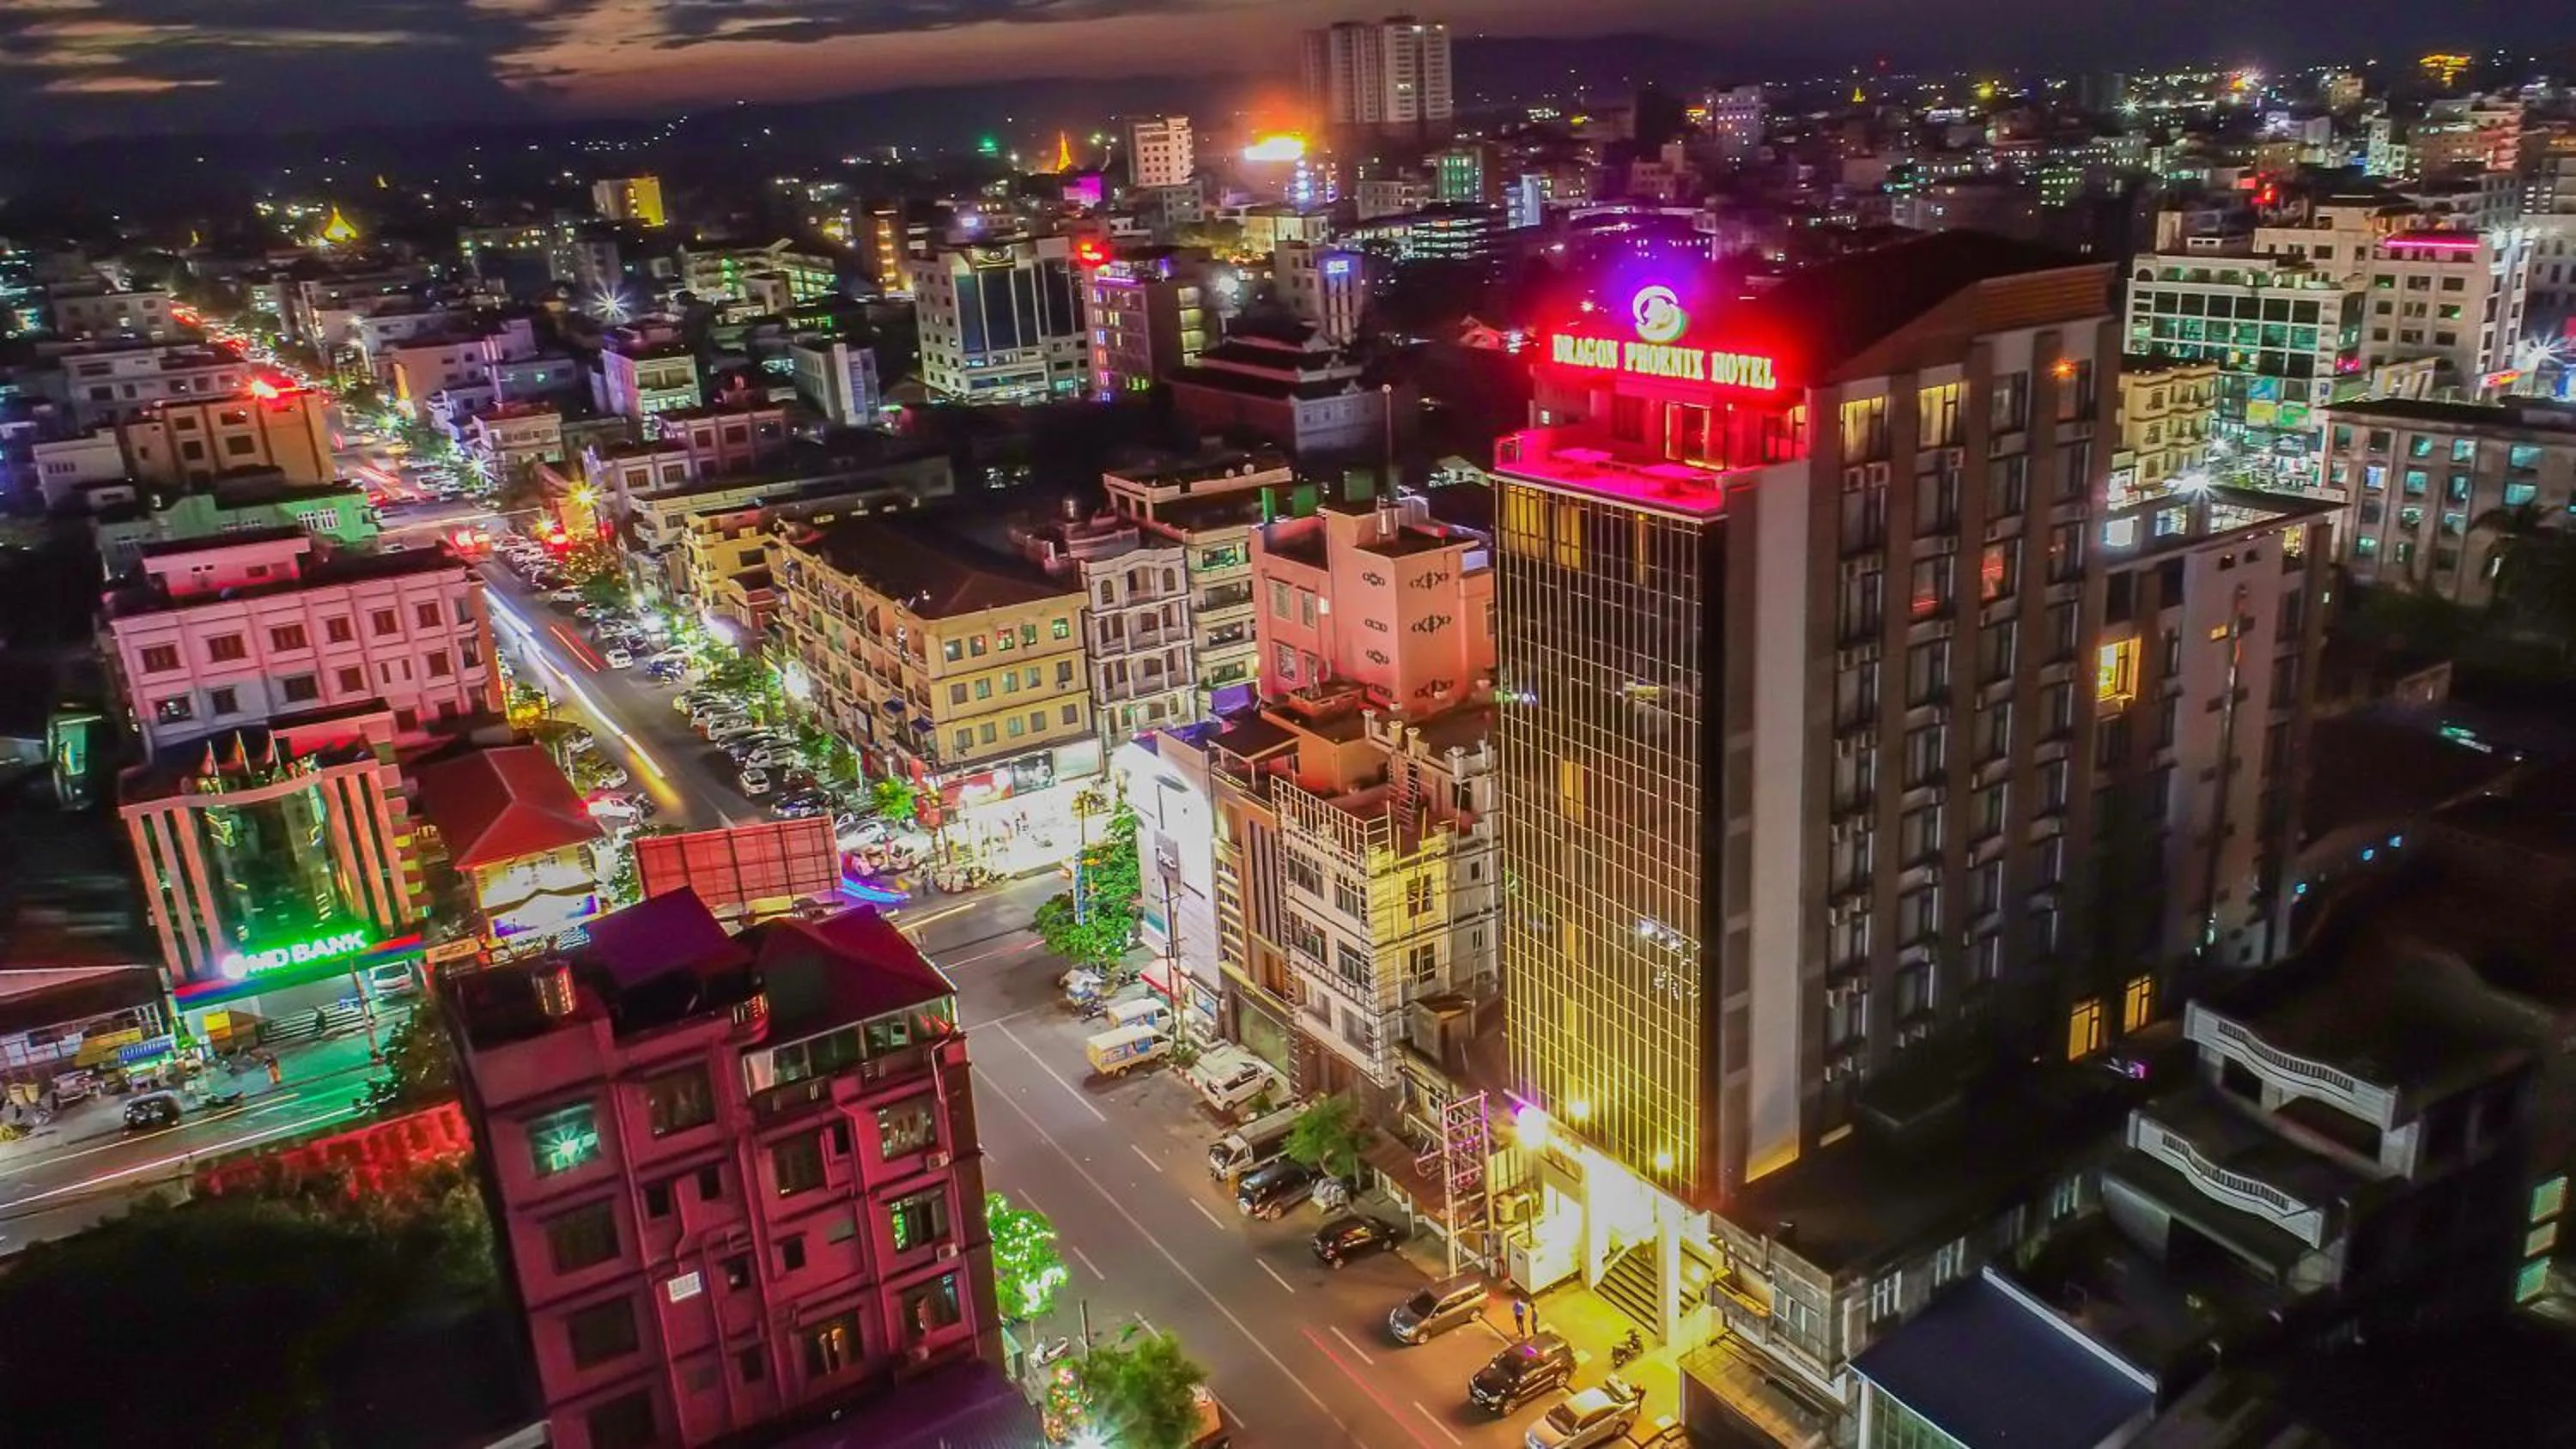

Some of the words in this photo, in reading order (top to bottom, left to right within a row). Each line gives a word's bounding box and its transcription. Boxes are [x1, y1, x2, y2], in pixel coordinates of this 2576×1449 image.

[1552, 334, 1618, 368] DRAGON
[1625, 343, 1704, 379] PHOENIX
[1711, 352, 1777, 391] HOTEL
[291, 931, 367, 963] BANK
